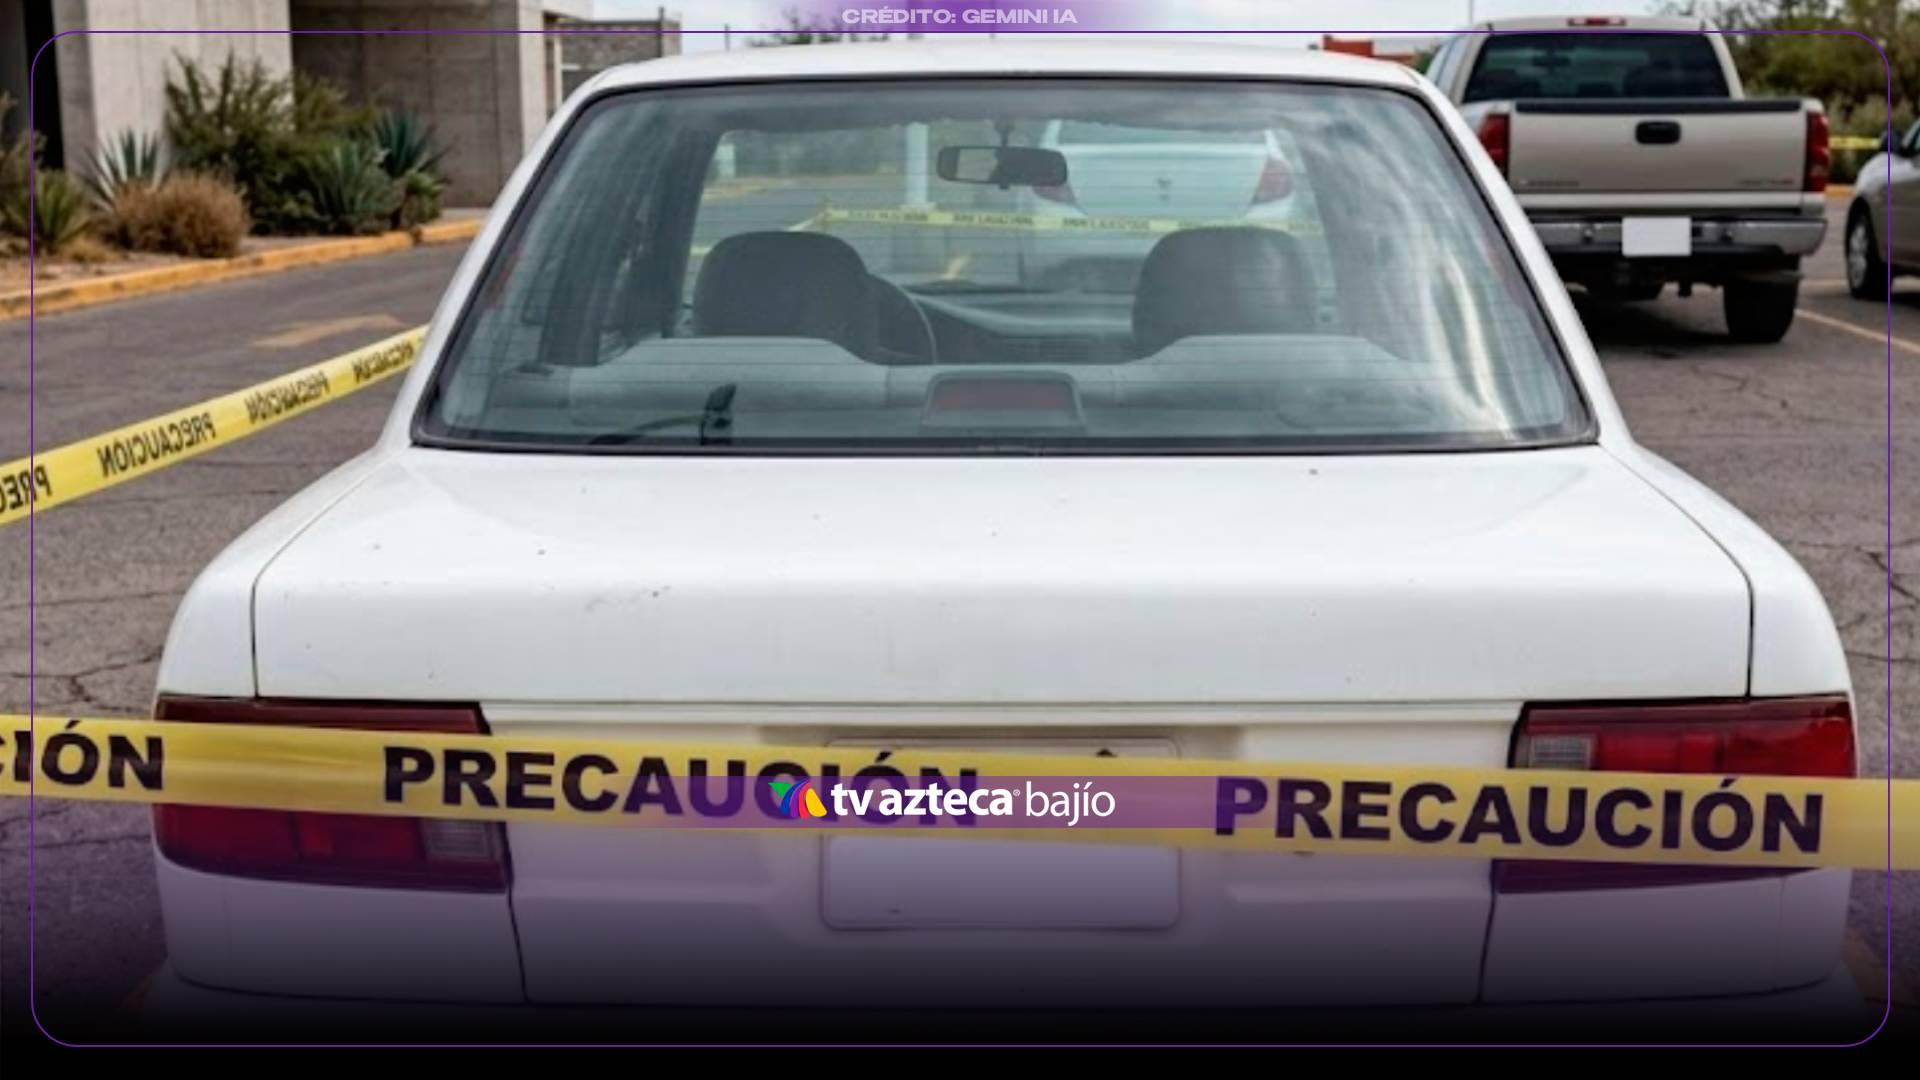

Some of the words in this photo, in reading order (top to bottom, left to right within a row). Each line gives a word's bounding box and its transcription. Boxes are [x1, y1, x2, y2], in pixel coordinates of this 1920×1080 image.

[0, 720, 163, 790] IÓN
[383, 746, 977, 826] PRECAUCIÓN
[1215, 776, 1823, 853] PRECAUCIÓN
